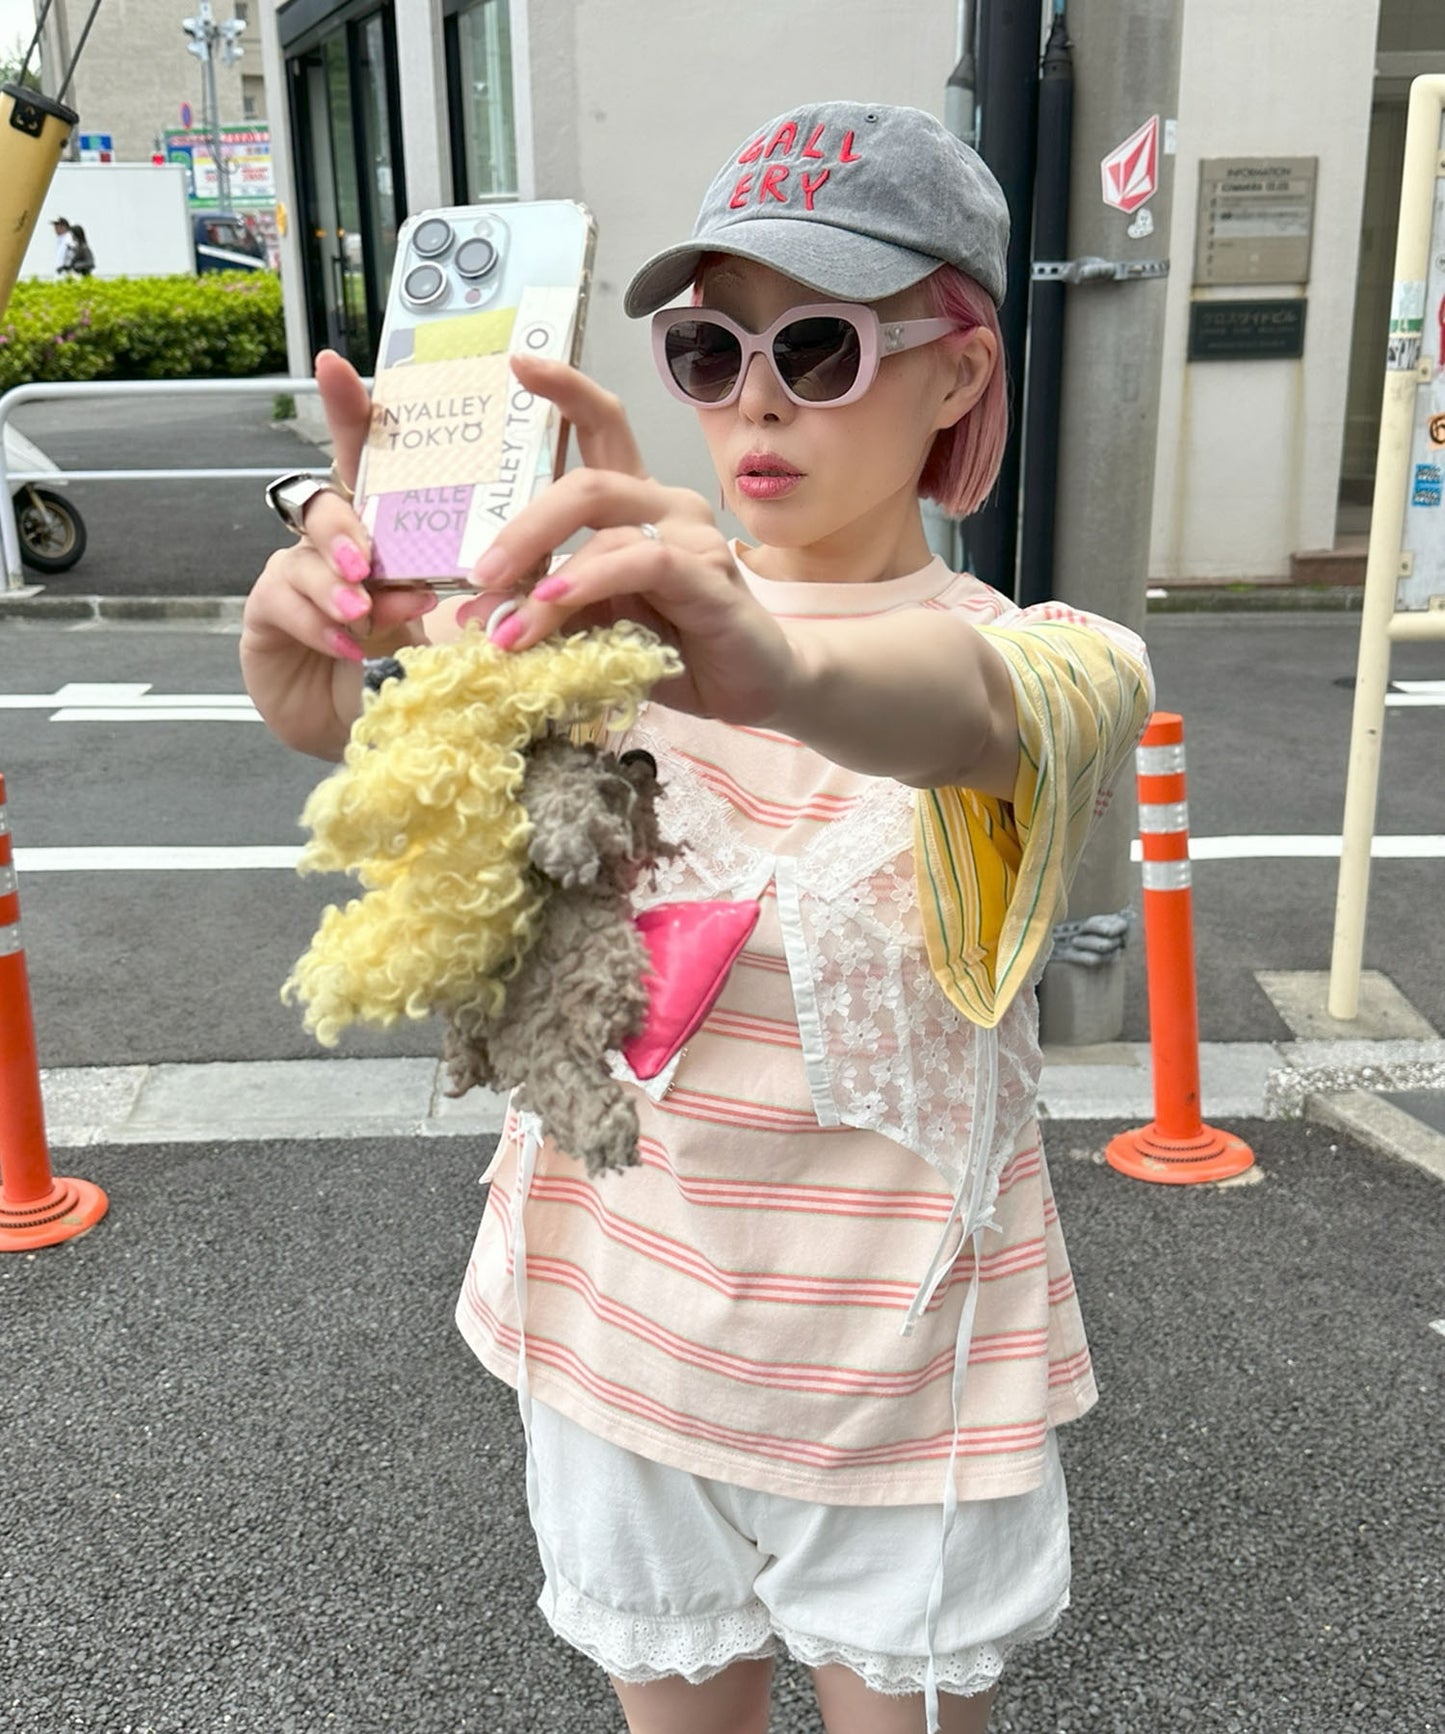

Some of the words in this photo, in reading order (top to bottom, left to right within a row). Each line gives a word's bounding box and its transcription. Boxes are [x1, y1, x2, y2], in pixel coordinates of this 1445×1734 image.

[737, 120, 862, 165] GALL
[729, 164, 831, 212] ERY
[383, 394, 493, 427] NYALLEY
[389, 422, 483, 450] TOKYO
[487, 440, 524, 521] ALLEY
